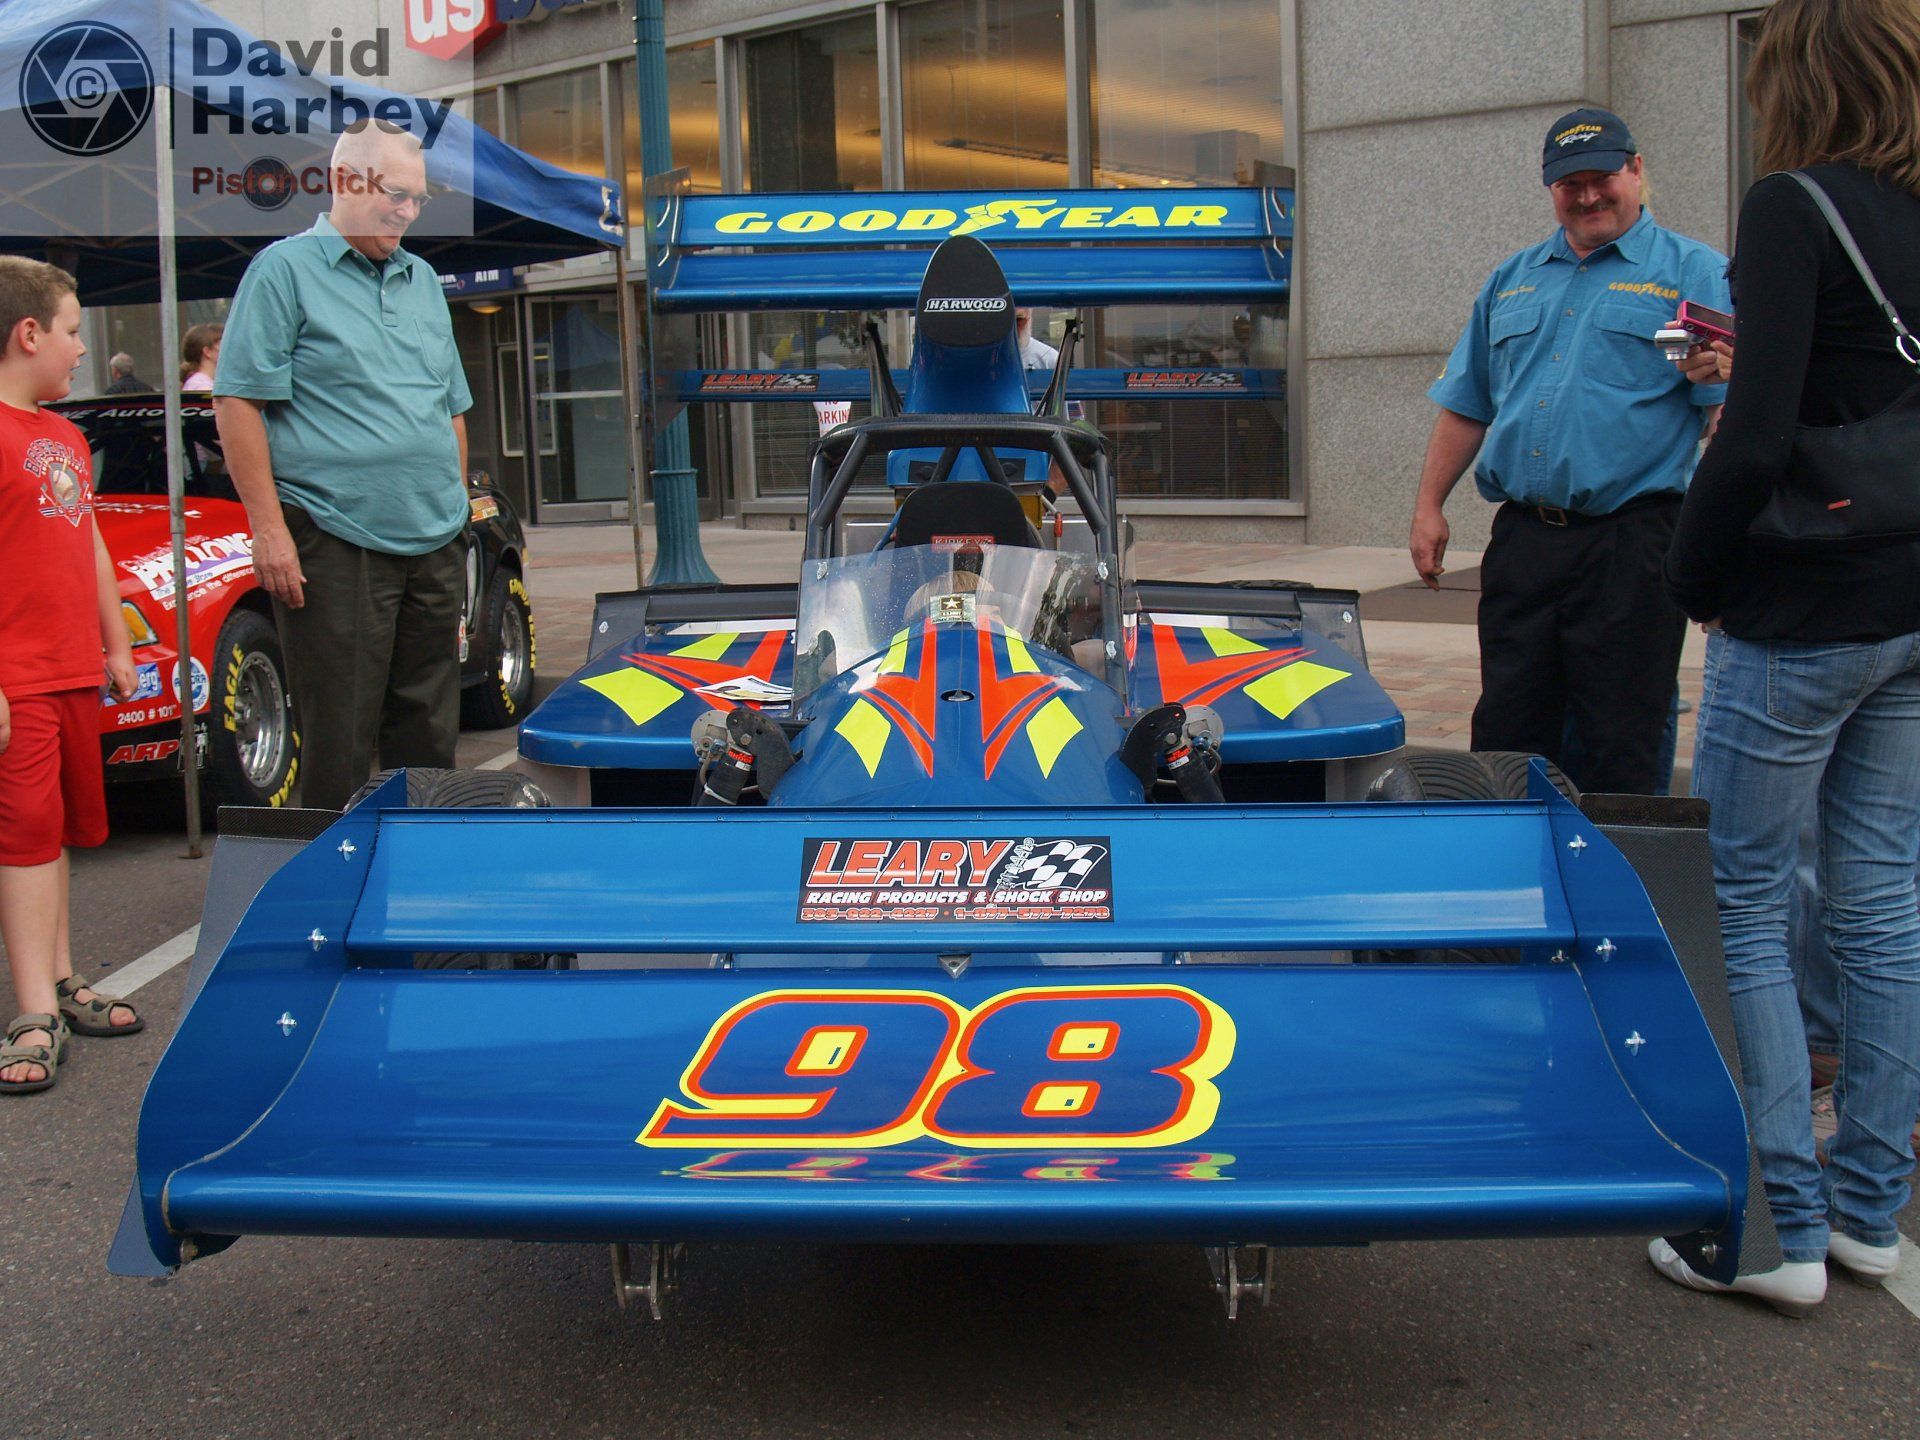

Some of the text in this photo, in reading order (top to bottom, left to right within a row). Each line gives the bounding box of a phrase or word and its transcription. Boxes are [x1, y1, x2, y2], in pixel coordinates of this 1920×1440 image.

[715, 200, 1229, 236] GOODYEAR
[1608, 281, 1681, 300] GOODYEAR
[927, 299, 1006, 311] HARWOOD
[703, 374, 782, 386] LEARY
[1127, 372, 1203, 384] LEARY
[98, 408, 164, 418] Auto
[223, 642, 245, 733] EAGLE
[117, 711, 146, 725] 2400
[148, 708, 157, 719] #
[106, 739, 180, 765] ARP
[806, 840, 1013, 888] LEARY
[806, 890, 1108, 905] RACING PRODUCTS & SHOCK SHOP
[635, 984, 1238, 1149] 98
